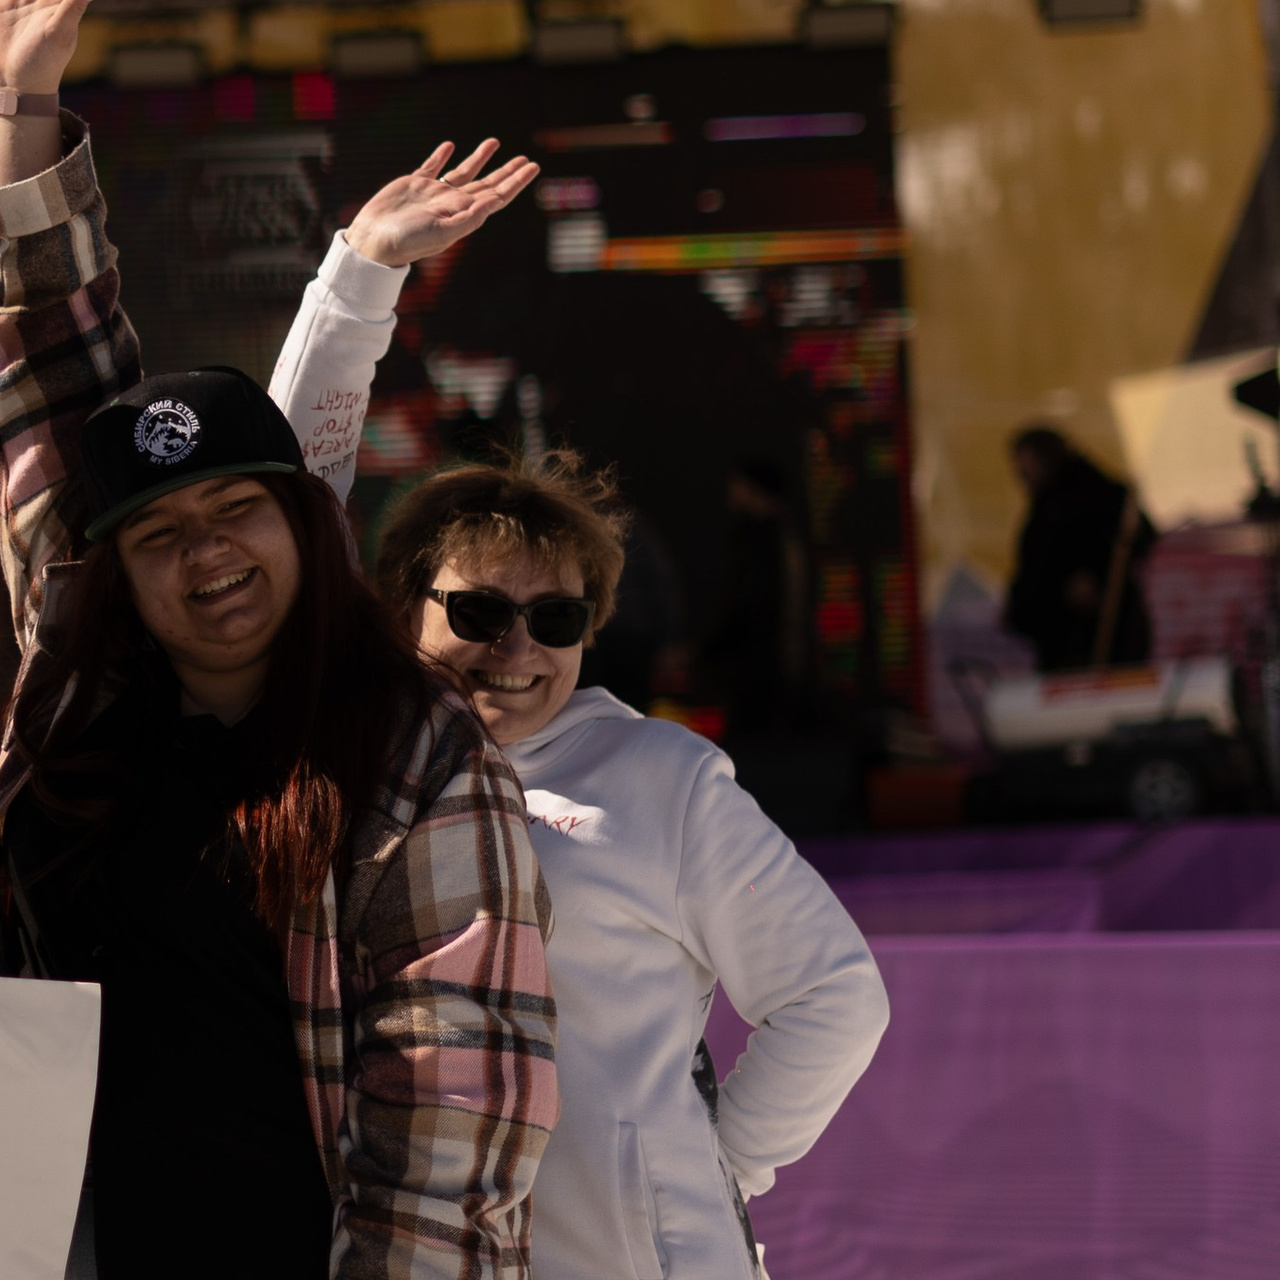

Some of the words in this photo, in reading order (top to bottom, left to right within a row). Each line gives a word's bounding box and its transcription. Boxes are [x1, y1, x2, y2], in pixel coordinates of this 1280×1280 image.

[133, 399, 173, 453] СИБИРСКИЙ
[175, 402, 201, 434] СТИЛЬ
[149, 454, 164, 465] MY
[165, 440, 199, 466] SIBERIA
